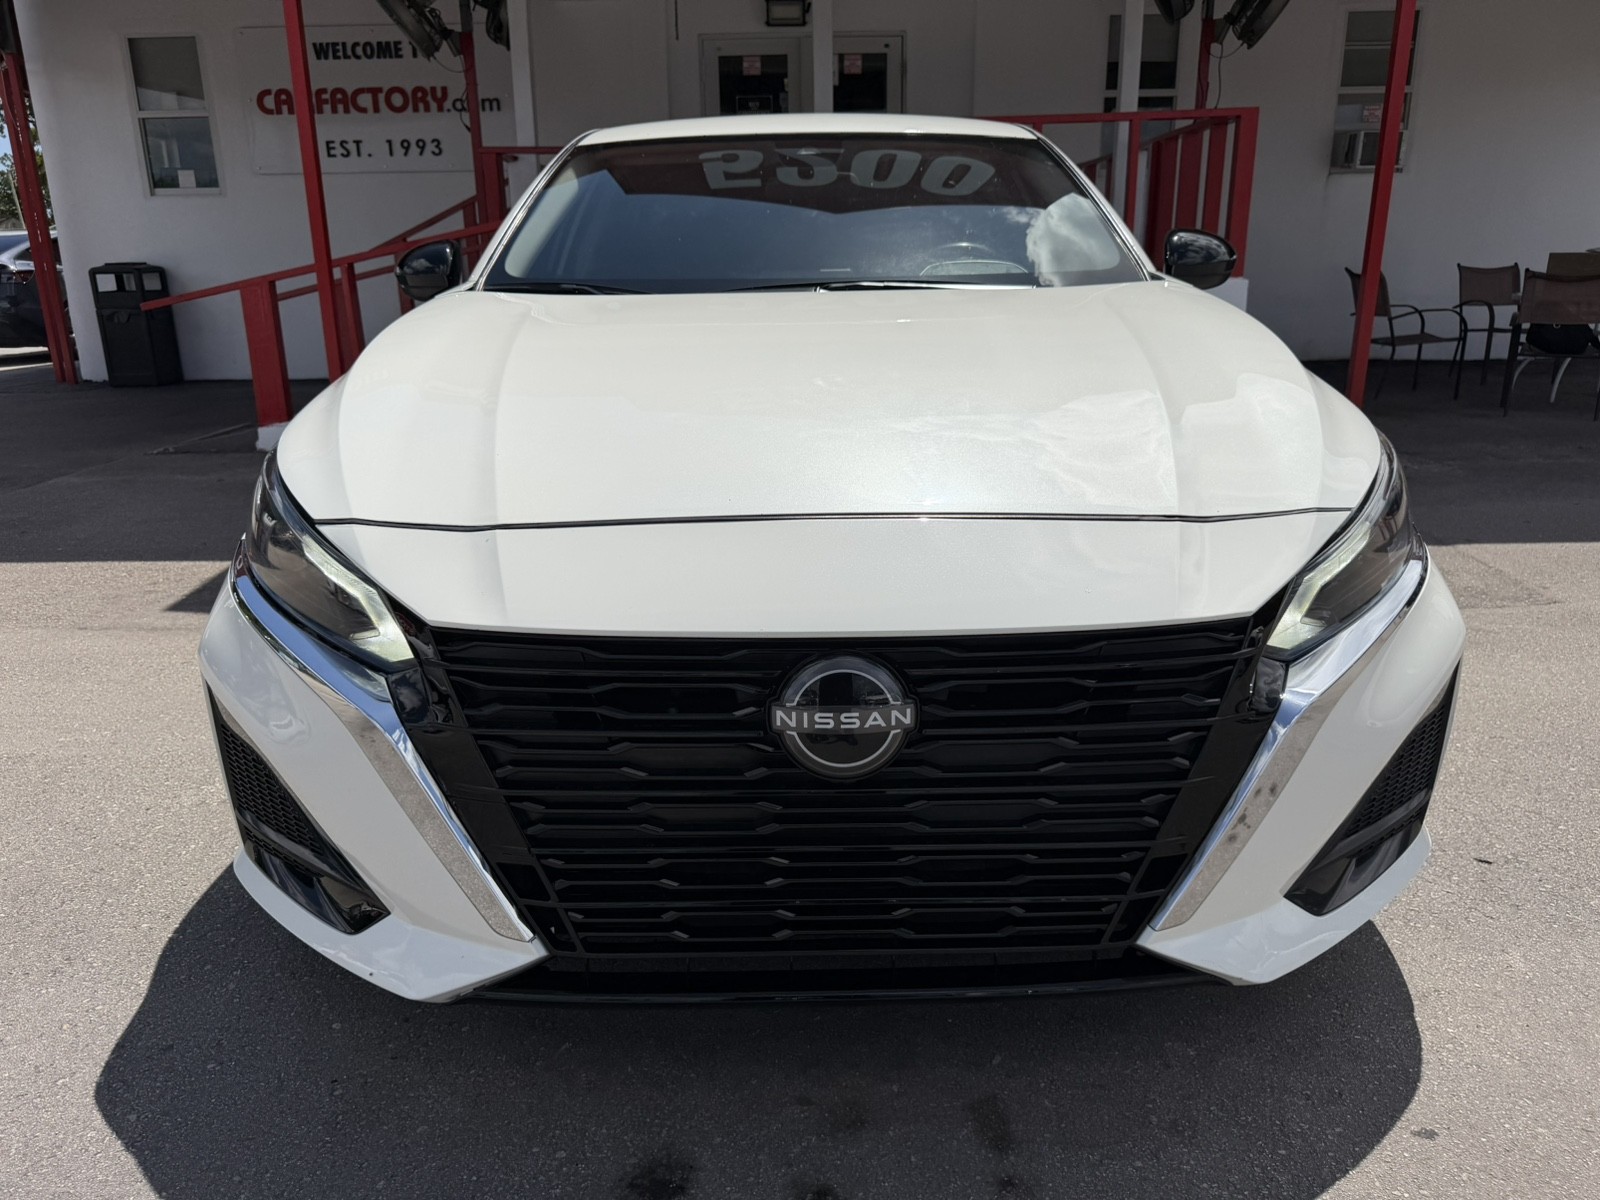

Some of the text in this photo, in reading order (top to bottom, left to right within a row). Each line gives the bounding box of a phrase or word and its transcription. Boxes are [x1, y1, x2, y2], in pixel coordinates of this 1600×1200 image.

[312, 41, 403, 60] WELCOME
[325, 138, 443, 158] EST. 1993
[775, 708, 912, 729] NISSAN
